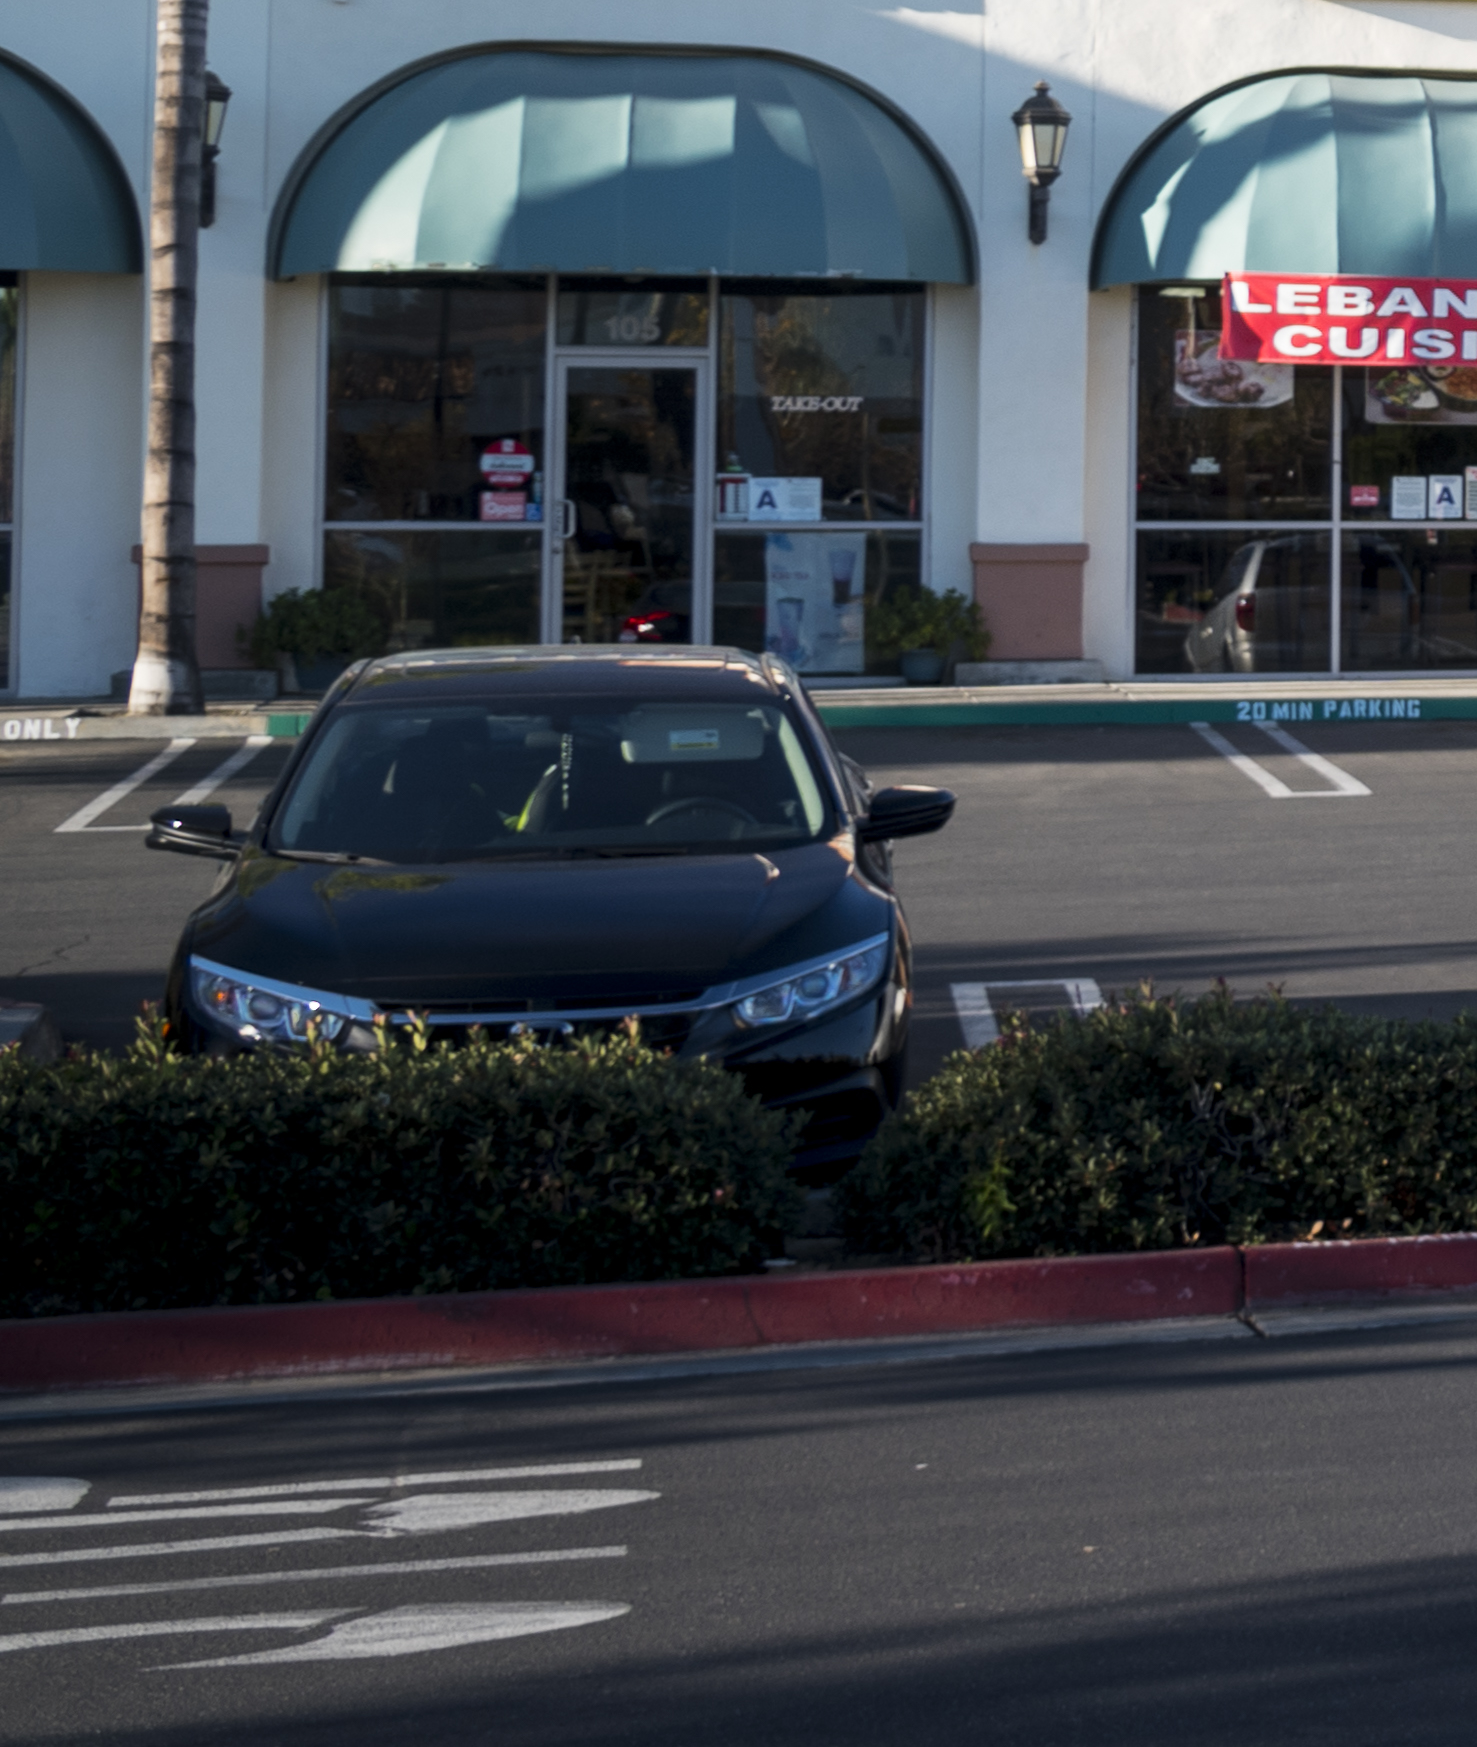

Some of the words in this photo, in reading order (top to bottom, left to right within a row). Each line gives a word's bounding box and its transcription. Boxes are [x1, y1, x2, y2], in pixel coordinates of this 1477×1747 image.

[604, 315, 661, 342] 105
[770, 396, 864, 412] TAKE-OUT
[757, 489, 778, 509] A
[1436, 484, 1456, 506] A
[1236, 701, 1267, 721] 20
[1272, 701, 1314, 721] MIN
[1322, 698, 1421, 719] PARKING
[4, 717, 82, 740] ONLY
